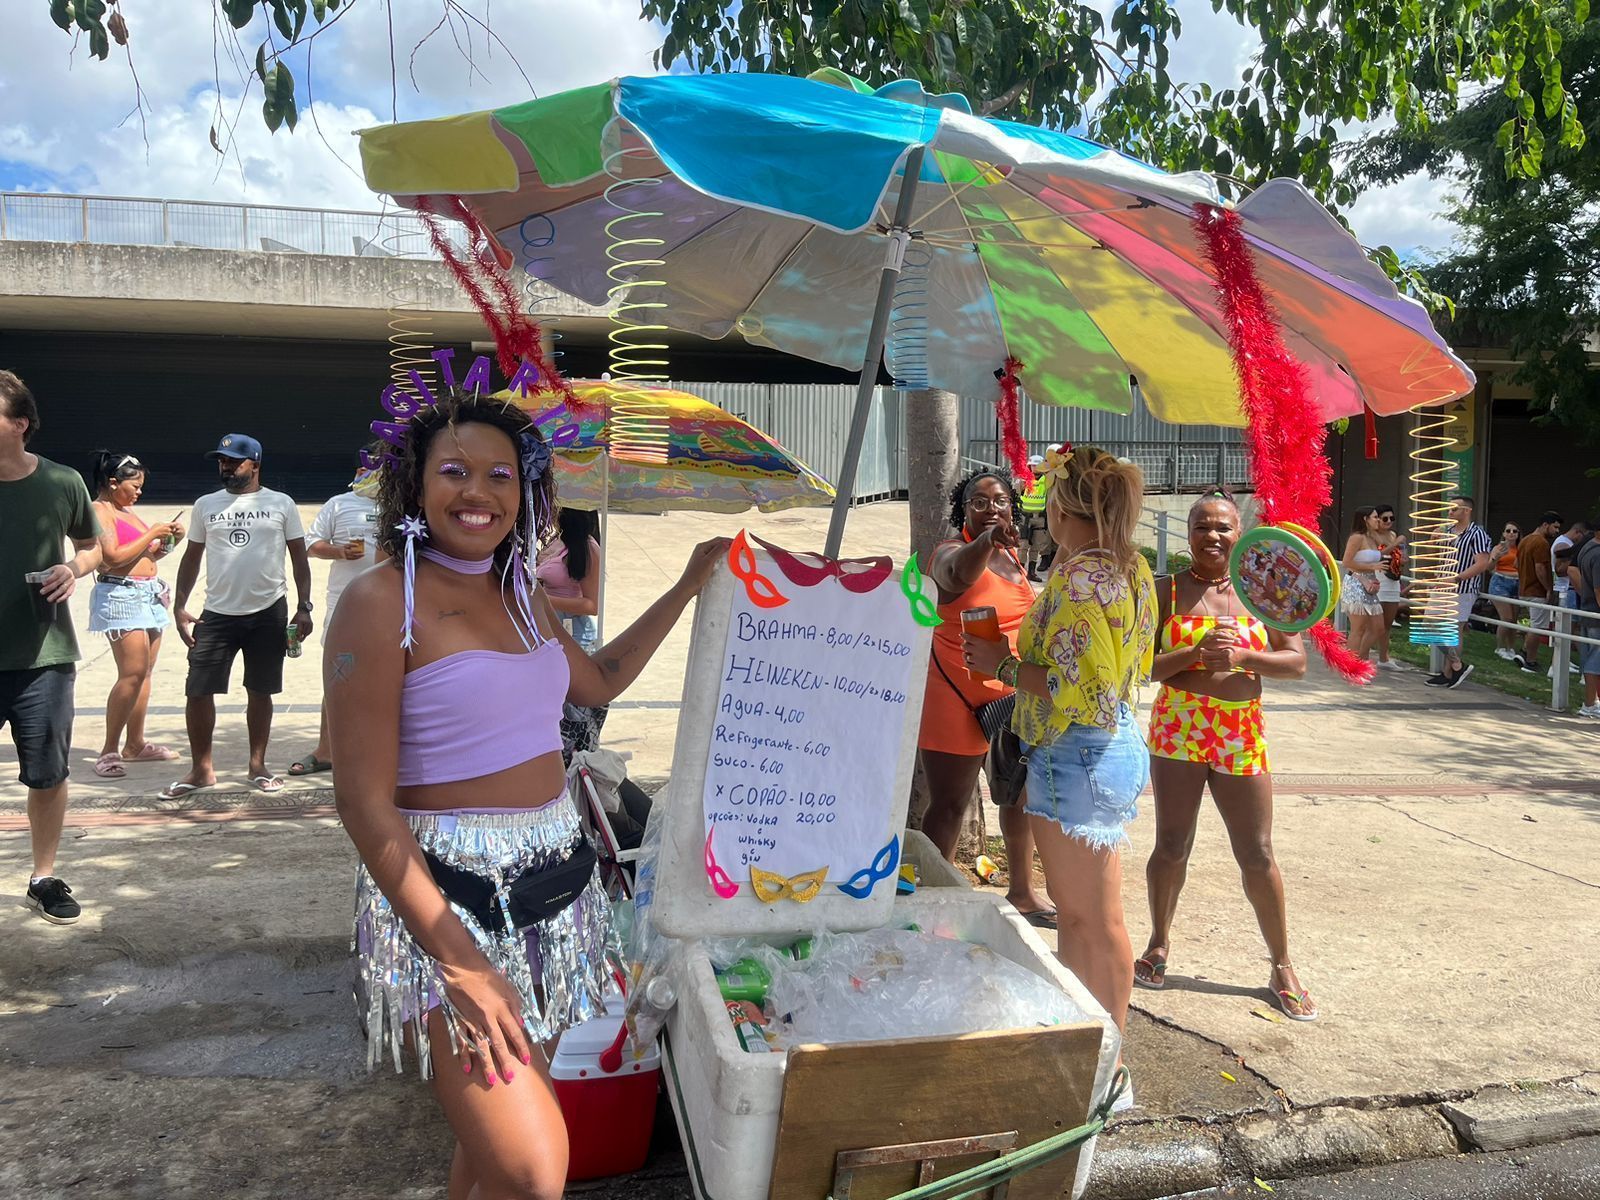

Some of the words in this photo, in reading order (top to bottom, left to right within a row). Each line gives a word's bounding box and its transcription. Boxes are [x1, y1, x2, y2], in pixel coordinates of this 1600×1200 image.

[210, 510, 270, 522] BALMAIN
[737, 612, 817, 641] BRAHMA
[725, 654, 823, 690] HEINEKEN
[774, 705, 805, 724] 4,00
[715, 724, 793, 750] Refrigerante
[803, 741, 831, 757] 6,00
[714, 753, 747, 768] Suco
[760, 757, 784, 774] 6,00
[729, 784, 787, 806] COPÃO
[799, 791, 836, 808] 10,00
[796, 812, 836, 825] 20,00
